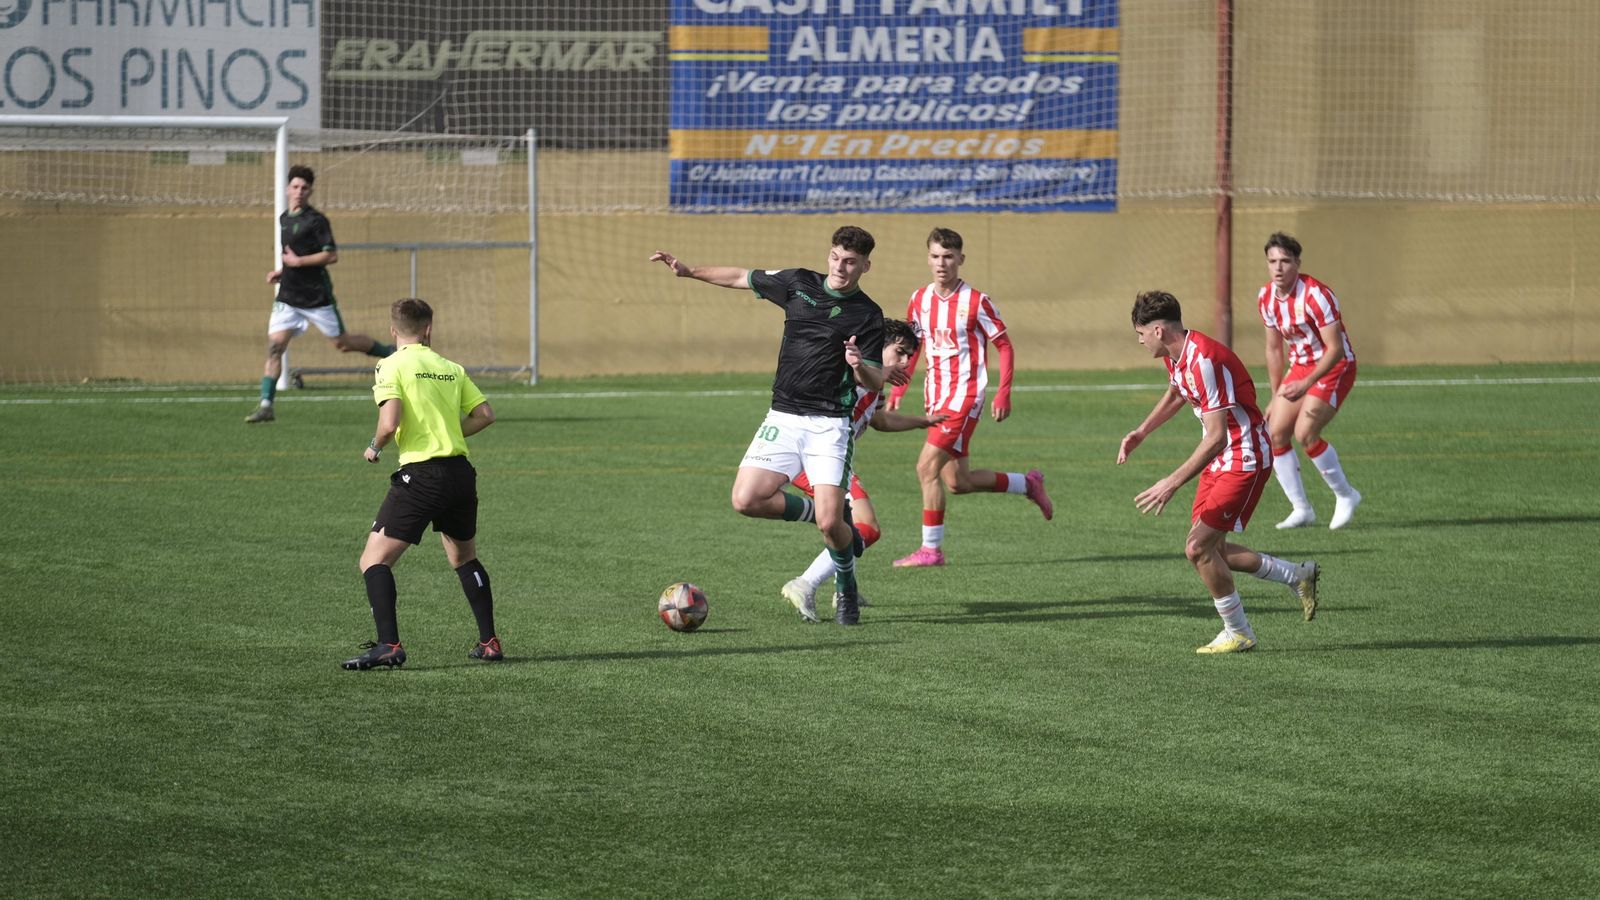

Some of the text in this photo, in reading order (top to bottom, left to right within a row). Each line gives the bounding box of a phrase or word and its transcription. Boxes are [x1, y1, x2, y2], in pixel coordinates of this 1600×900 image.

[786, 19, 1005, 62] ALMERÍA
[0, 46, 309, 109] OS PINOS
[706, 70, 1085, 98] ¡Venta para todos
[767, 97, 1034, 126] los públicos!
[879, 133, 1045, 156] Precios
[875, 164, 973, 181] Gasolinera
[974, 164, 1010, 181] San
[758, 425, 780, 442] 10
